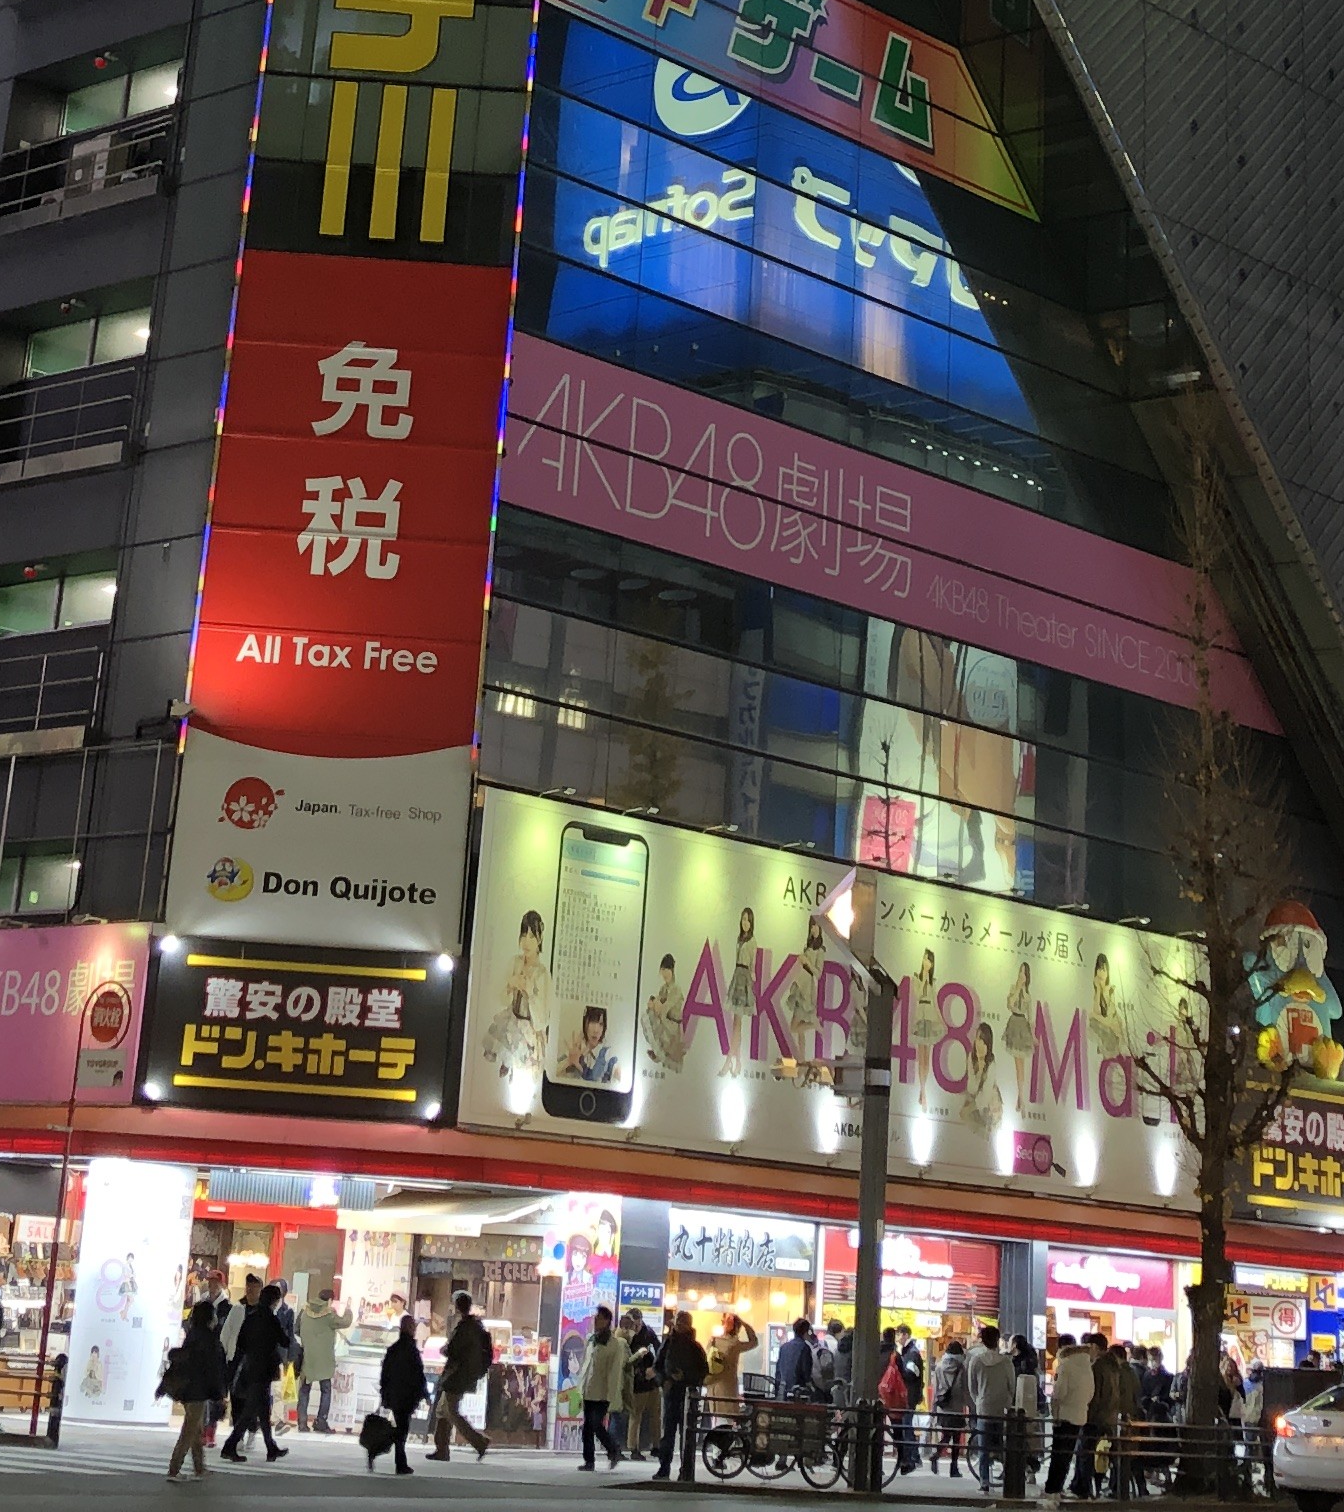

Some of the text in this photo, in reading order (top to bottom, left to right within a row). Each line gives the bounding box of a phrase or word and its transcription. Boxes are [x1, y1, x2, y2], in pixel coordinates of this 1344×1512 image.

[297, 340, 415, 581] 免税
[517, 372, 917, 602] AKB48劇場
[926, 574, 991, 624] AKB48
[996, 593, 1080, 650] Theater
[1084, 623, 1150, 675] SINCE
[237, 633, 439, 675] All Tax Free
[348, 802, 402, 822] Tax-free
[407, 804, 442, 825] Shop
[261, 870, 438, 907] Don Quijote
[202, 975, 405, 1030] 驚安の殿堂
[679, 939, 979, 1094] AKB48
[483, 1261, 503, 1282] ICE
[1278, 1307, 1296, 1327] 得
